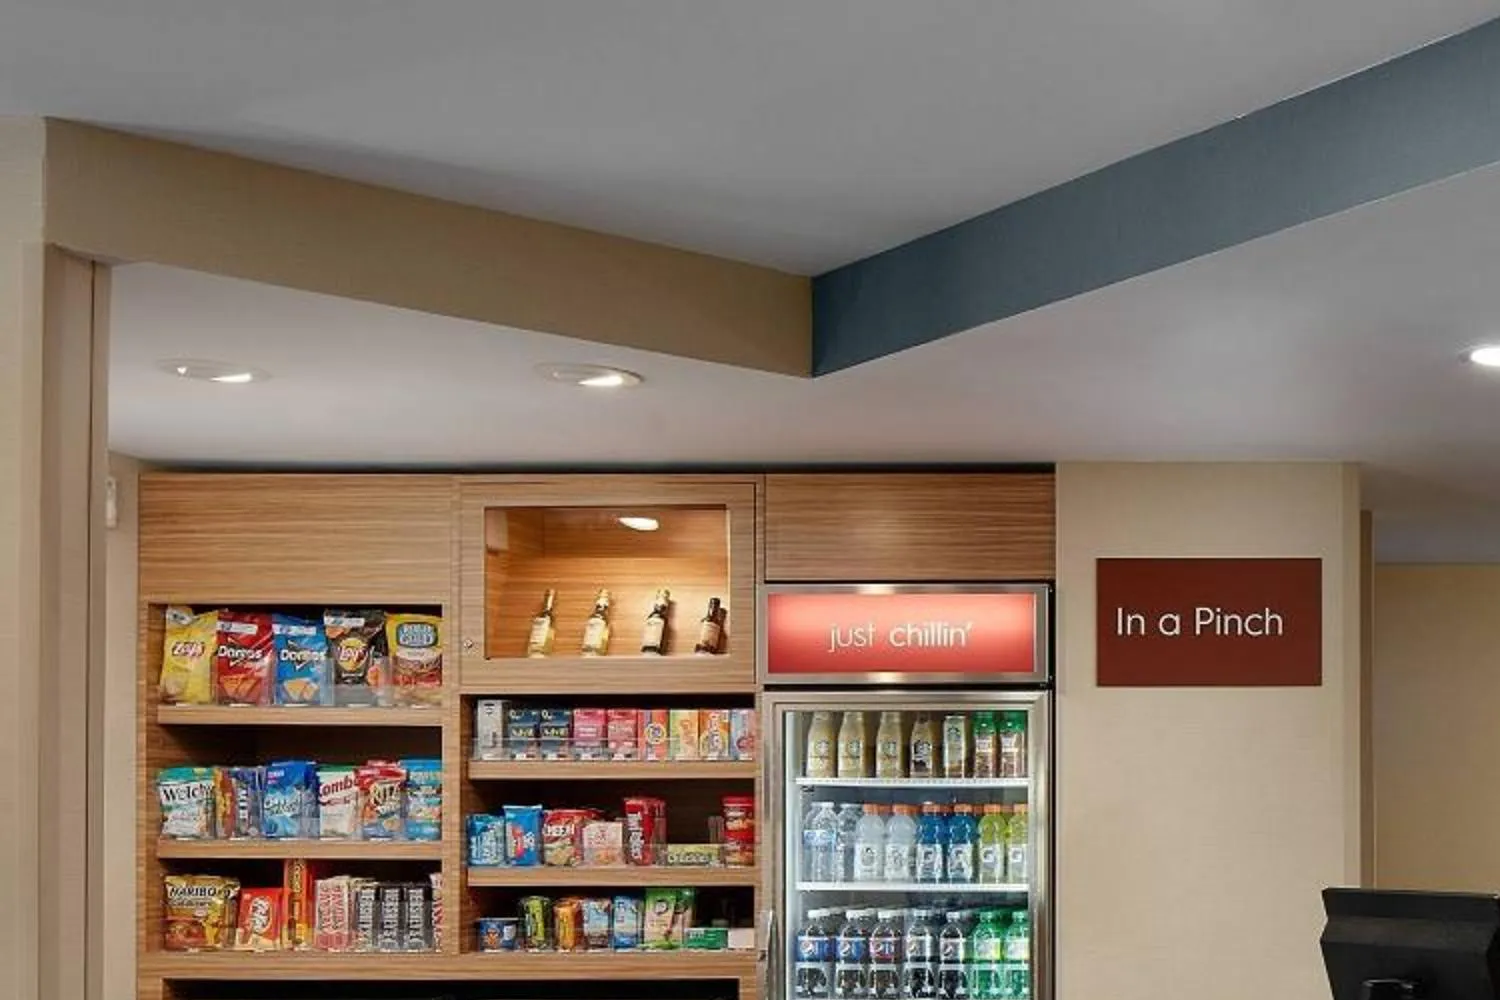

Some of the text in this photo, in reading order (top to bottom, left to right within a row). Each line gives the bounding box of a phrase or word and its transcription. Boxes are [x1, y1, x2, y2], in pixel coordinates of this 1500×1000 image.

[1116, 606, 1284, 636] In a Pinch
[828, 620, 973, 653] just chillin'
[218, 645, 263, 659] Doritos
[280, 648, 328, 662] Doritos
[168, 886, 217, 898] HARIBO
